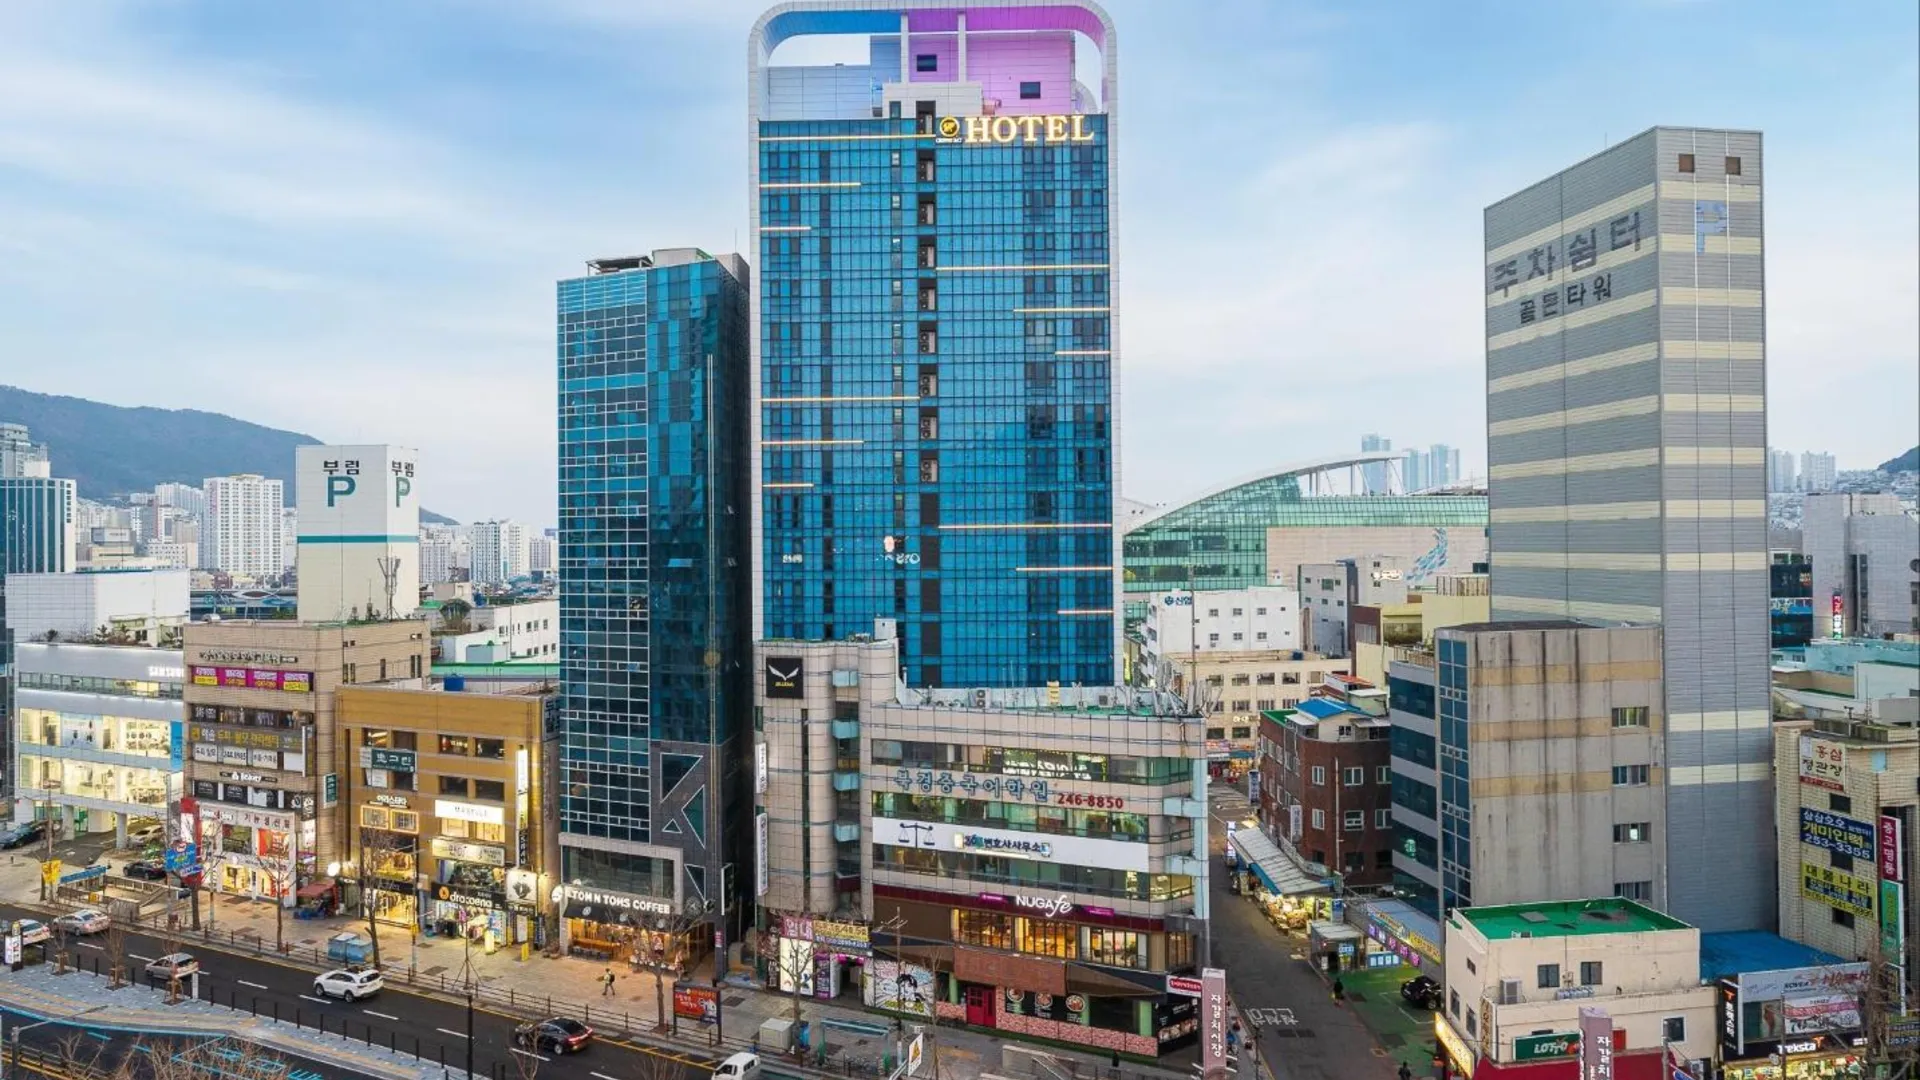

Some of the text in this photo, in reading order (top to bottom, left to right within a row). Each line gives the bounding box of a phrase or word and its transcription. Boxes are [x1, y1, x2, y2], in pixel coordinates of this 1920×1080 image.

[965, 115, 1094, 143] HOTEL
[1697, 200, 1728, 255] P
[1494, 211, 1641, 298] 주차쉼터
[1520, 273, 1611, 325] 골든타워
[323, 460, 360, 475] 부림
[391, 460, 414, 478] 부림
[328, 476, 356, 507] P
[396, 476, 411, 507] P
[1816, 745, 1843, 762] 홍삼
[1802, 759, 1842, 777] 정관장
[894, 770, 1048, 802] 북경중국어학원
[1057, 794, 1124, 809] 246-8850
[1804, 833, 1871, 860] 253-3355
[573, 890, 671, 915] TOM N TOMS COFFEE
[1211, 994, 1223, 1058] 자갈치시장
[1534, 1040, 1568, 1055] LOTTO
